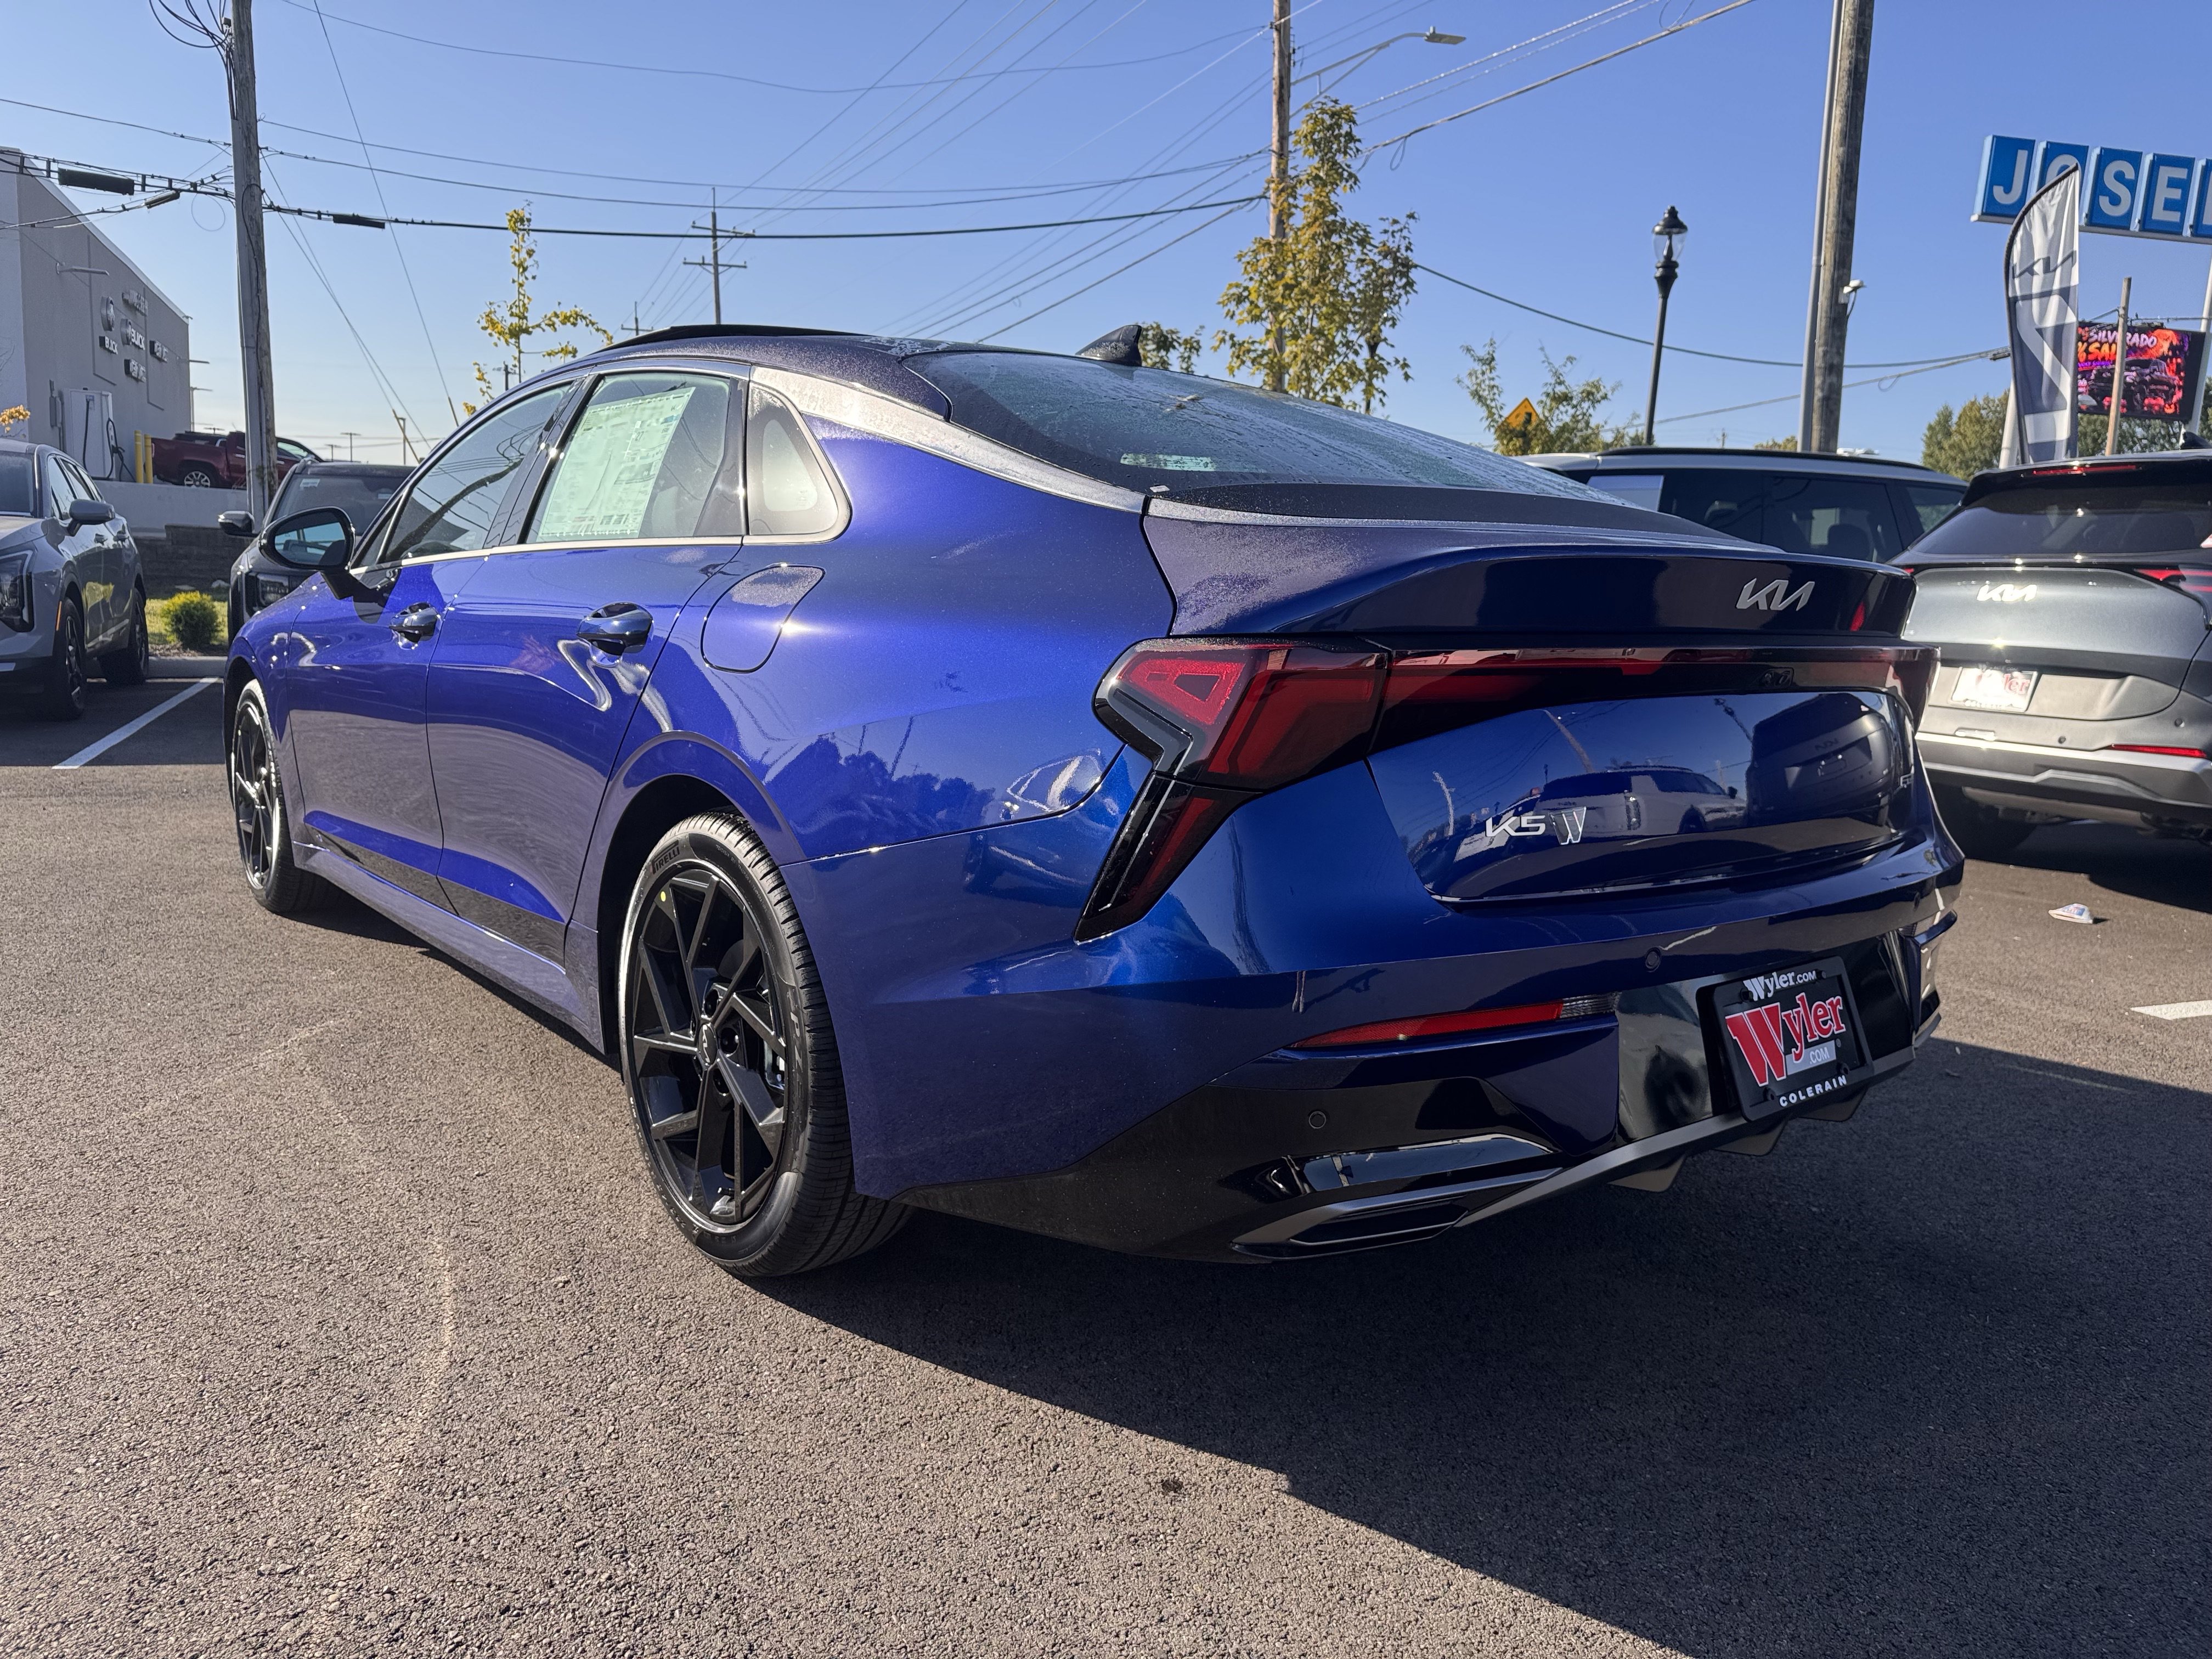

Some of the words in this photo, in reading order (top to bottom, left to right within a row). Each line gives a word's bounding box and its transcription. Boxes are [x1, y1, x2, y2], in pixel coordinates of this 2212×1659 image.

[1993, 149, 2212, 225] JSE
[2012, 250, 2077, 280] KIA
[105, 336, 118, 354] BUICK
[131, 328, 145, 351] BUICK
[2088, 342, 2117, 361] SAL
[2089, 329, 2157, 348] SILVRADO
[1735, 578, 1815, 611] KIA
[1976, 584, 2038, 602] KIA
[1485, 815, 1547, 838] K5
[651, 839, 680, 875] PIRELLI
[1725, 992, 1847, 1087] Wyler
[1779, 1075, 1848, 1107] COLERAIN
